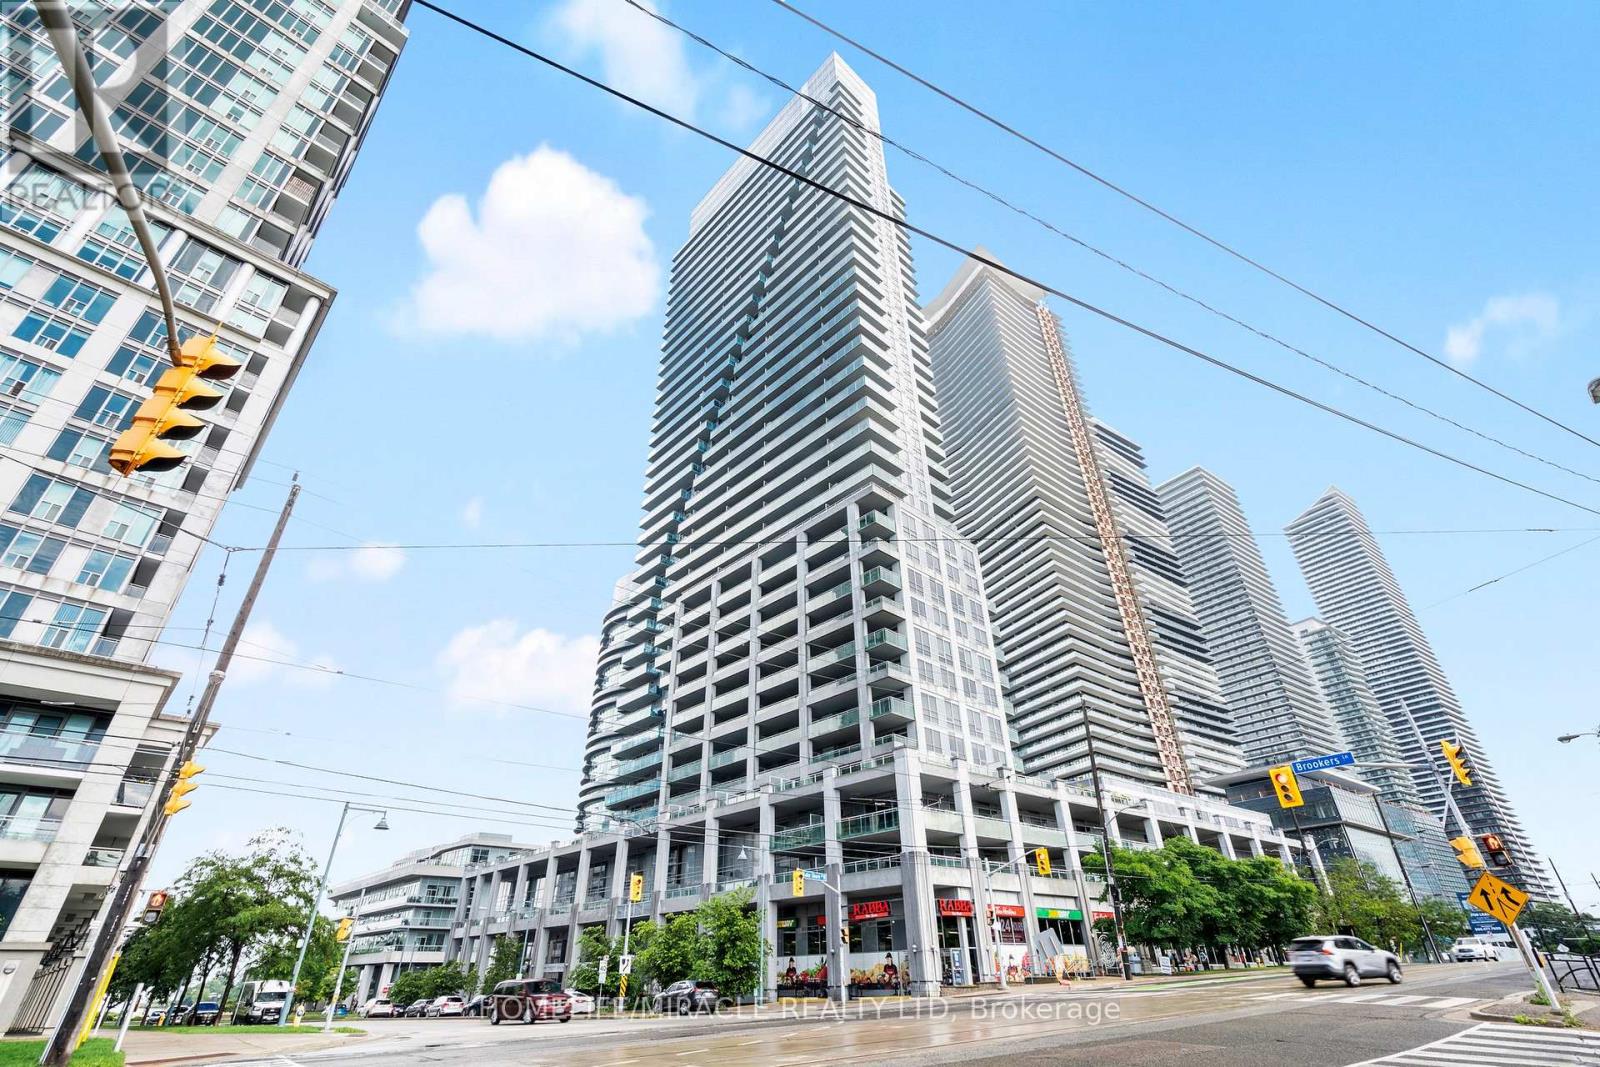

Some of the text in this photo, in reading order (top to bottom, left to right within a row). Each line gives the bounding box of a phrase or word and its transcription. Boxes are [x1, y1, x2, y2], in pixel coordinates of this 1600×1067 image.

[1296, 757, 1340, 771] Brookers
[853, 900, 889, 915] RABBA
[939, 897, 974, 911] RABBA
